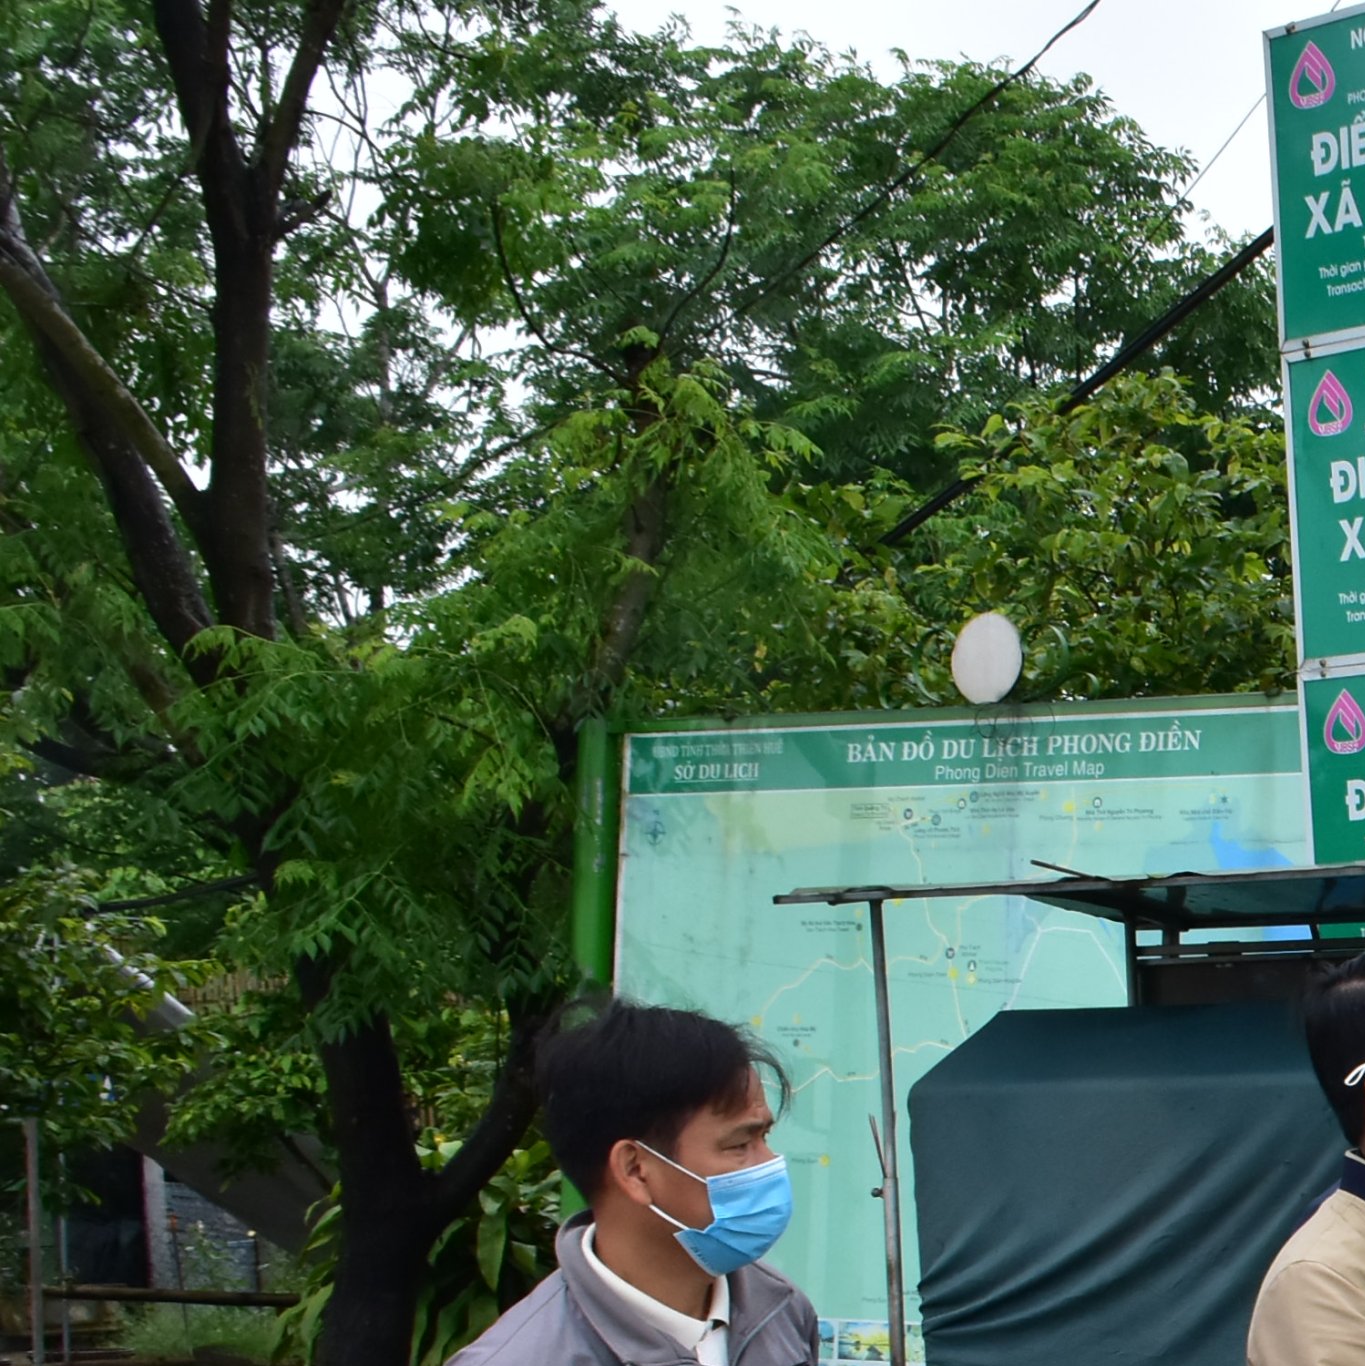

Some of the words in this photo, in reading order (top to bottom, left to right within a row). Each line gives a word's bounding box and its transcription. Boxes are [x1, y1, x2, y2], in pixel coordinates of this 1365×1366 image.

[1305, 179, 1363, 238] XÃ
[847, 735, 896, 763] BẢN
[901, 730, 934, 761] ĐỒ
[942, 738, 976, 759] DU
[982, 736, 1039, 762] LỊCH
[1047, 732, 1132, 756] PHONG
[1138, 720, 1202, 753] ĐIỀN
[675, 760, 695, 780] SỞ
[700, 763, 721, 779] DU
[935, 765, 980, 782] Phong
[1024, 761, 1068, 777] Travel
[1073, 761, 1104, 778] Map
